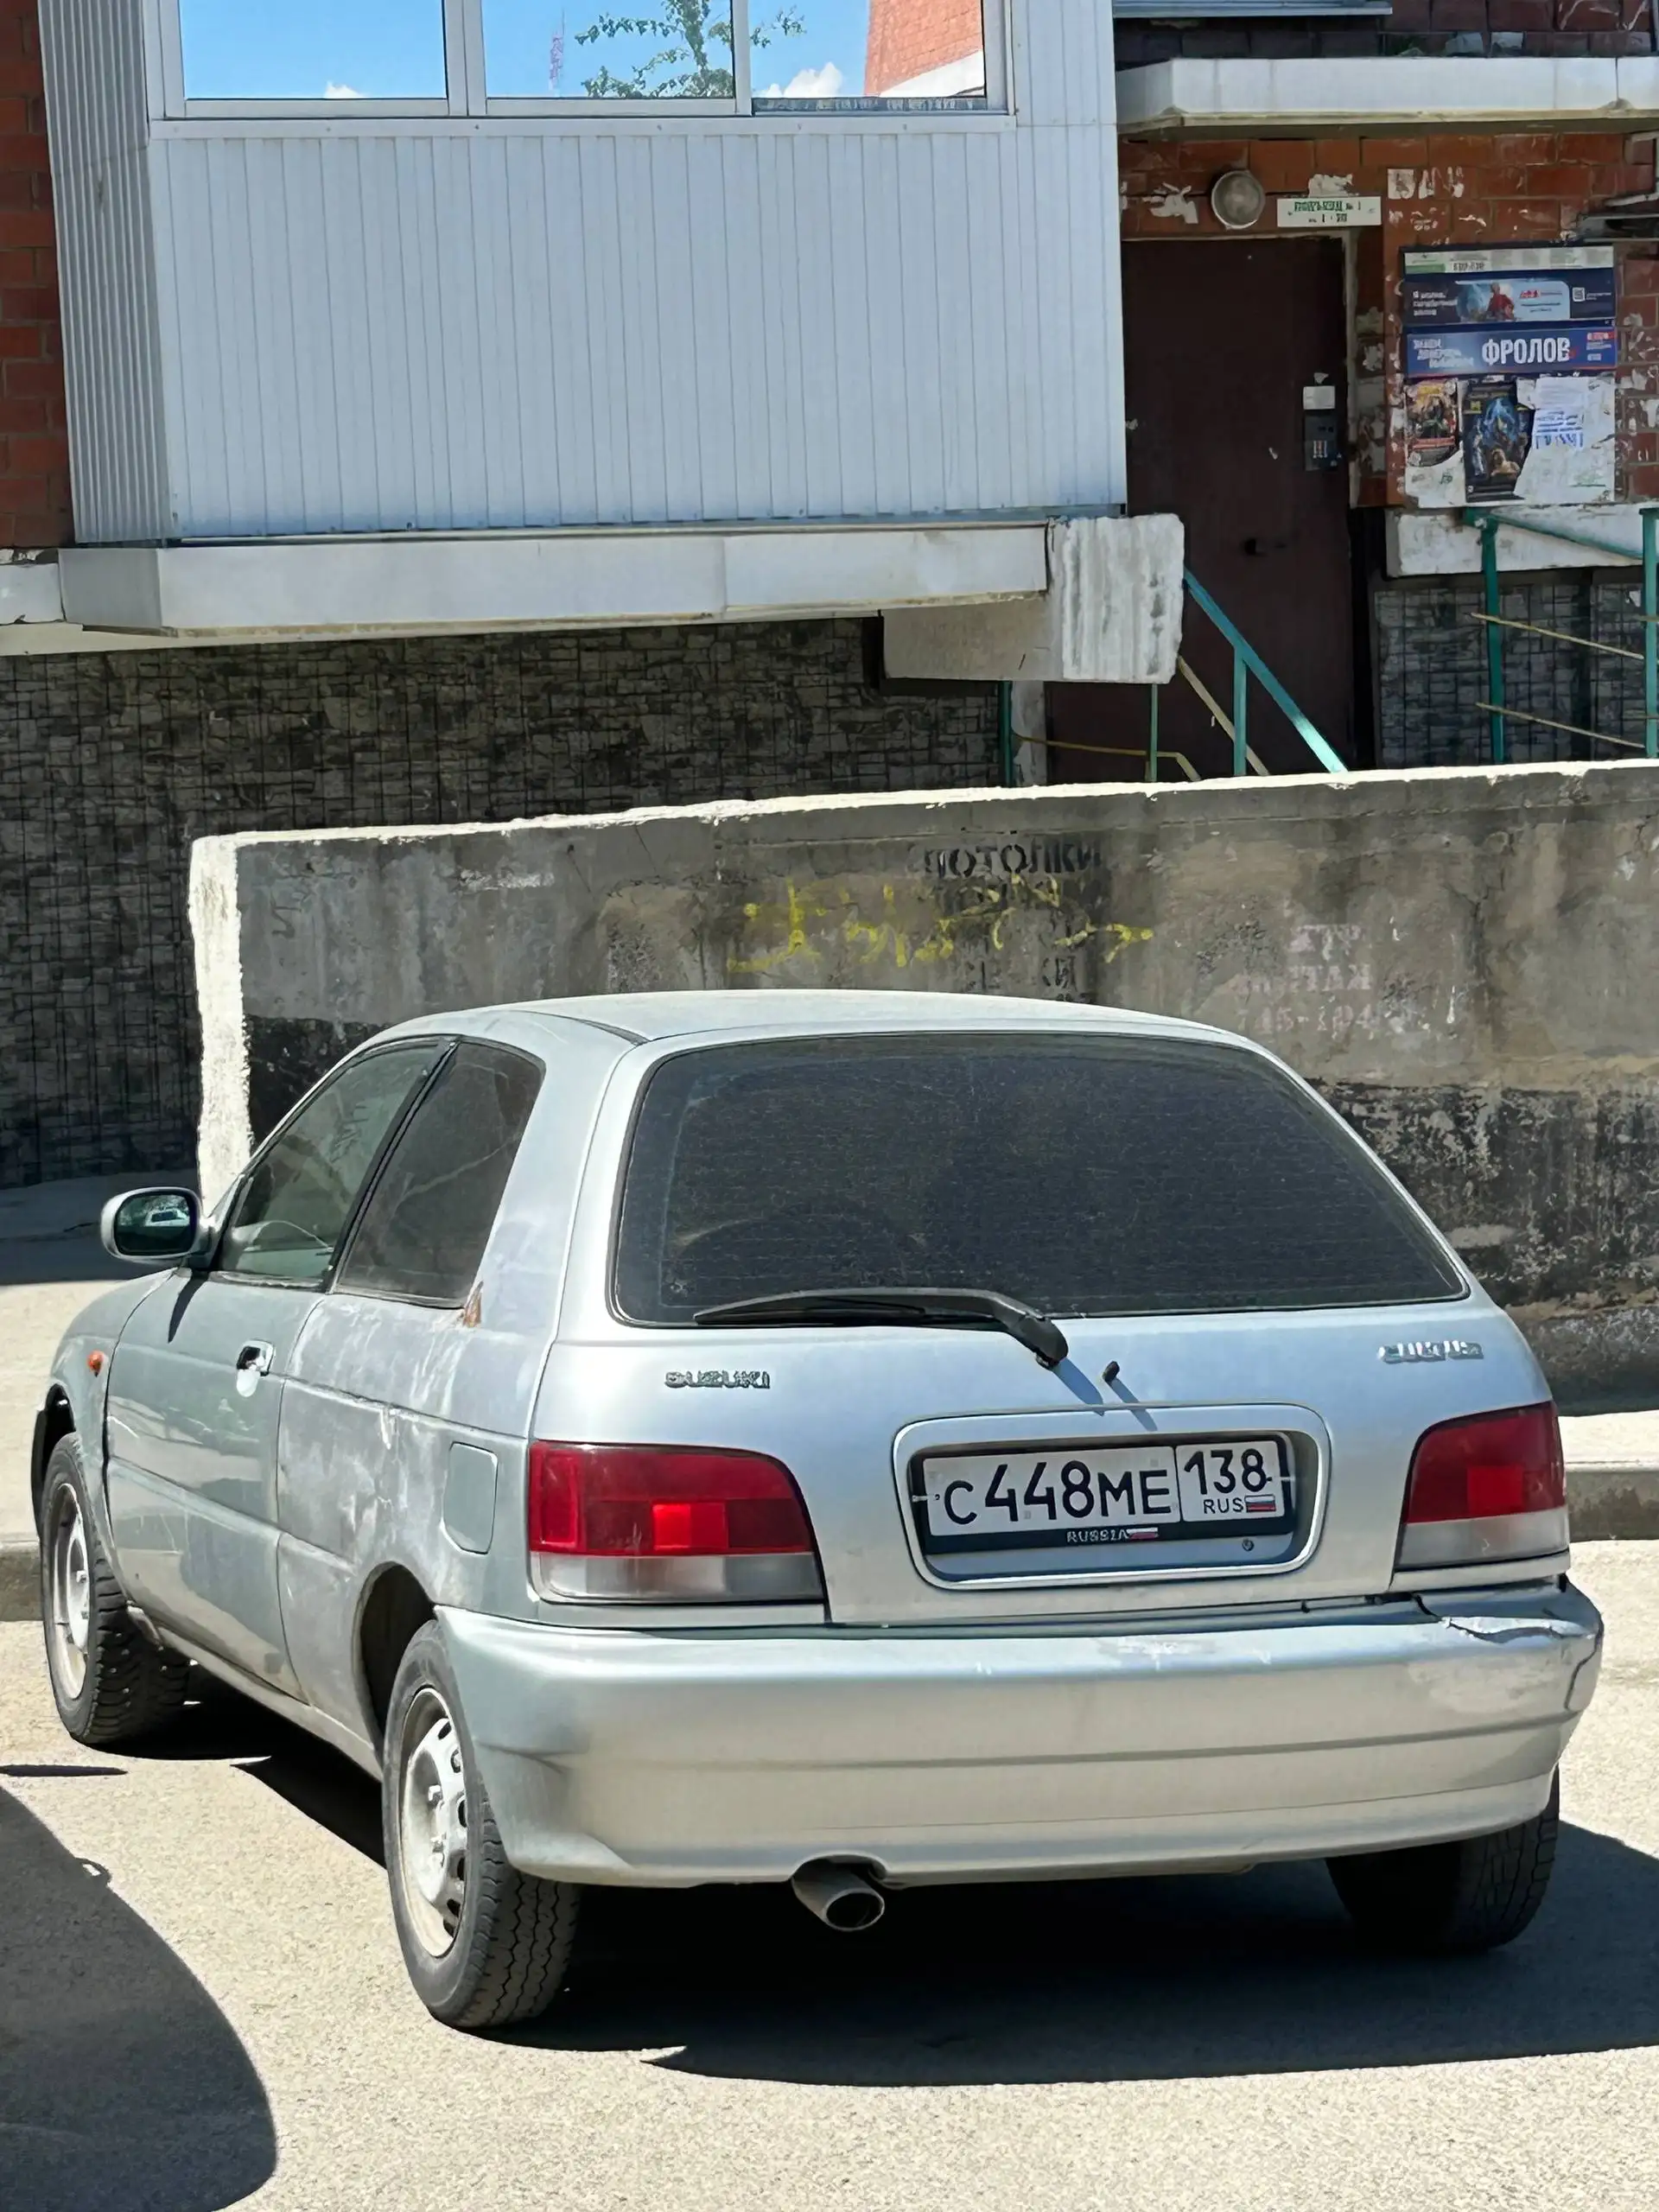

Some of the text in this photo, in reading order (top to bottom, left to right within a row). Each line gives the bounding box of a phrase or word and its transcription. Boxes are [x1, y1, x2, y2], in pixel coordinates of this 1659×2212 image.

[1481, 337, 1571, 365] ФРОЛОВ
[664, 1370, 771, 1389] SUZUKI
[1183, 1447, 1268, 1496] 138
[1203, 1497, 1244, 1515] RUS
[1065, 1528, 1130, 1543] RUSSIA
